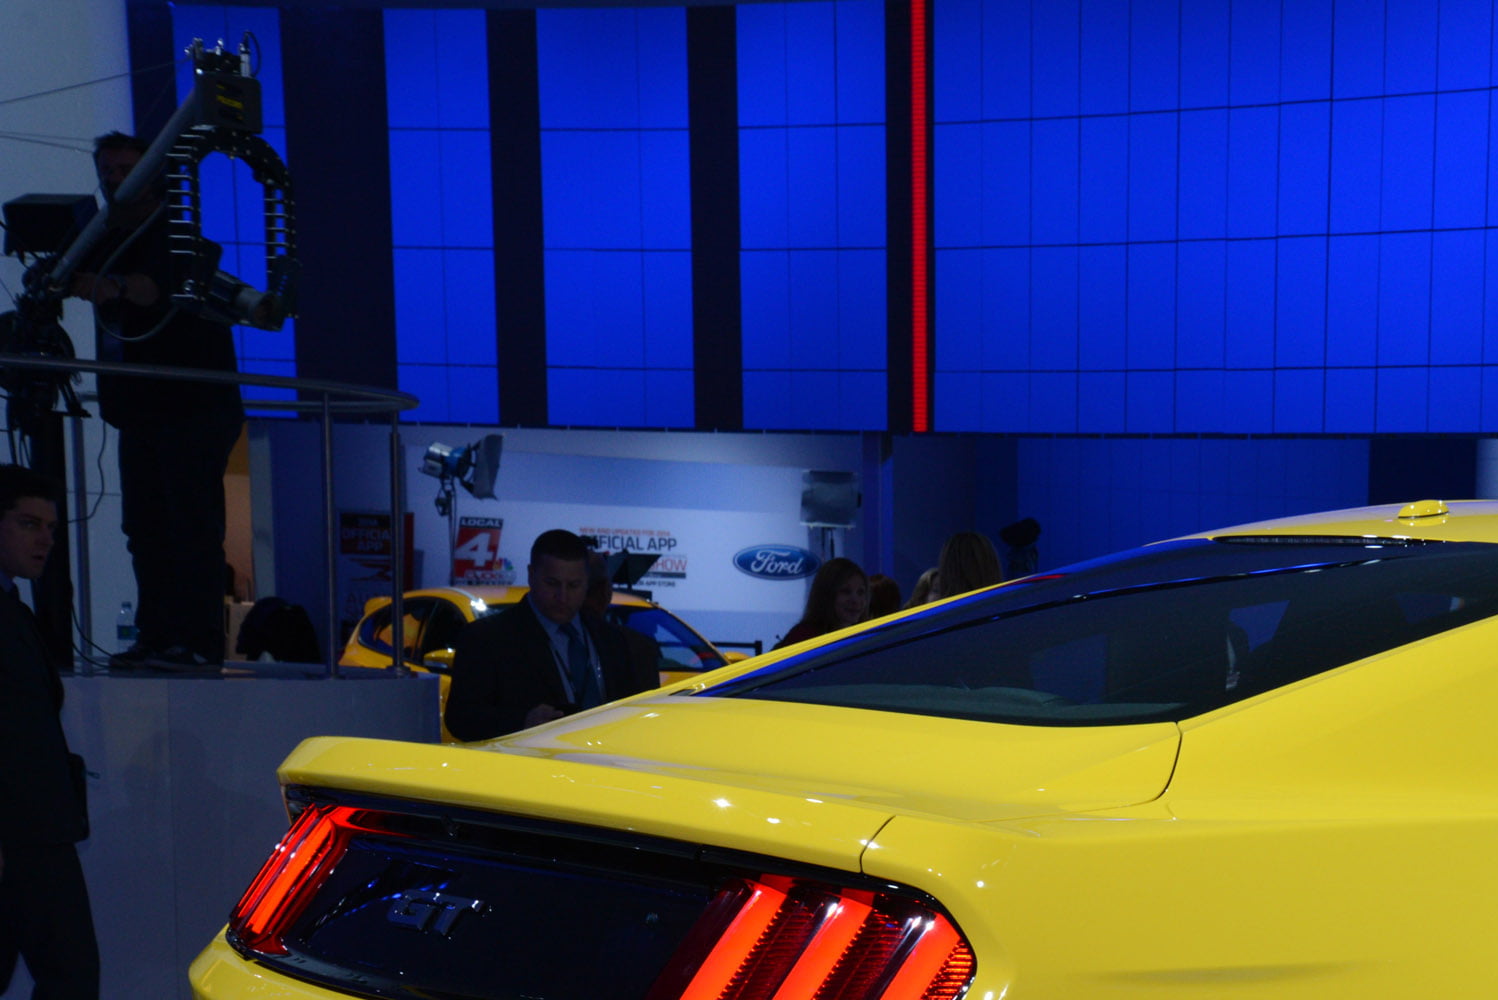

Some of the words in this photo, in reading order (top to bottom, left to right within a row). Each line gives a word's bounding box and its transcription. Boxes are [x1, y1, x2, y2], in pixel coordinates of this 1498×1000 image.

[461, 518, 501, 527] LOCAL
[342, 528, 391, 540] OFFICIA
[584, 535, 644, 550] FICIAL
[647, 537, 677, 551] APP
[455, 532, 494, 567] 4
[751, 549, 803, 573] Ford
[385, 888, 484, 936] GT
